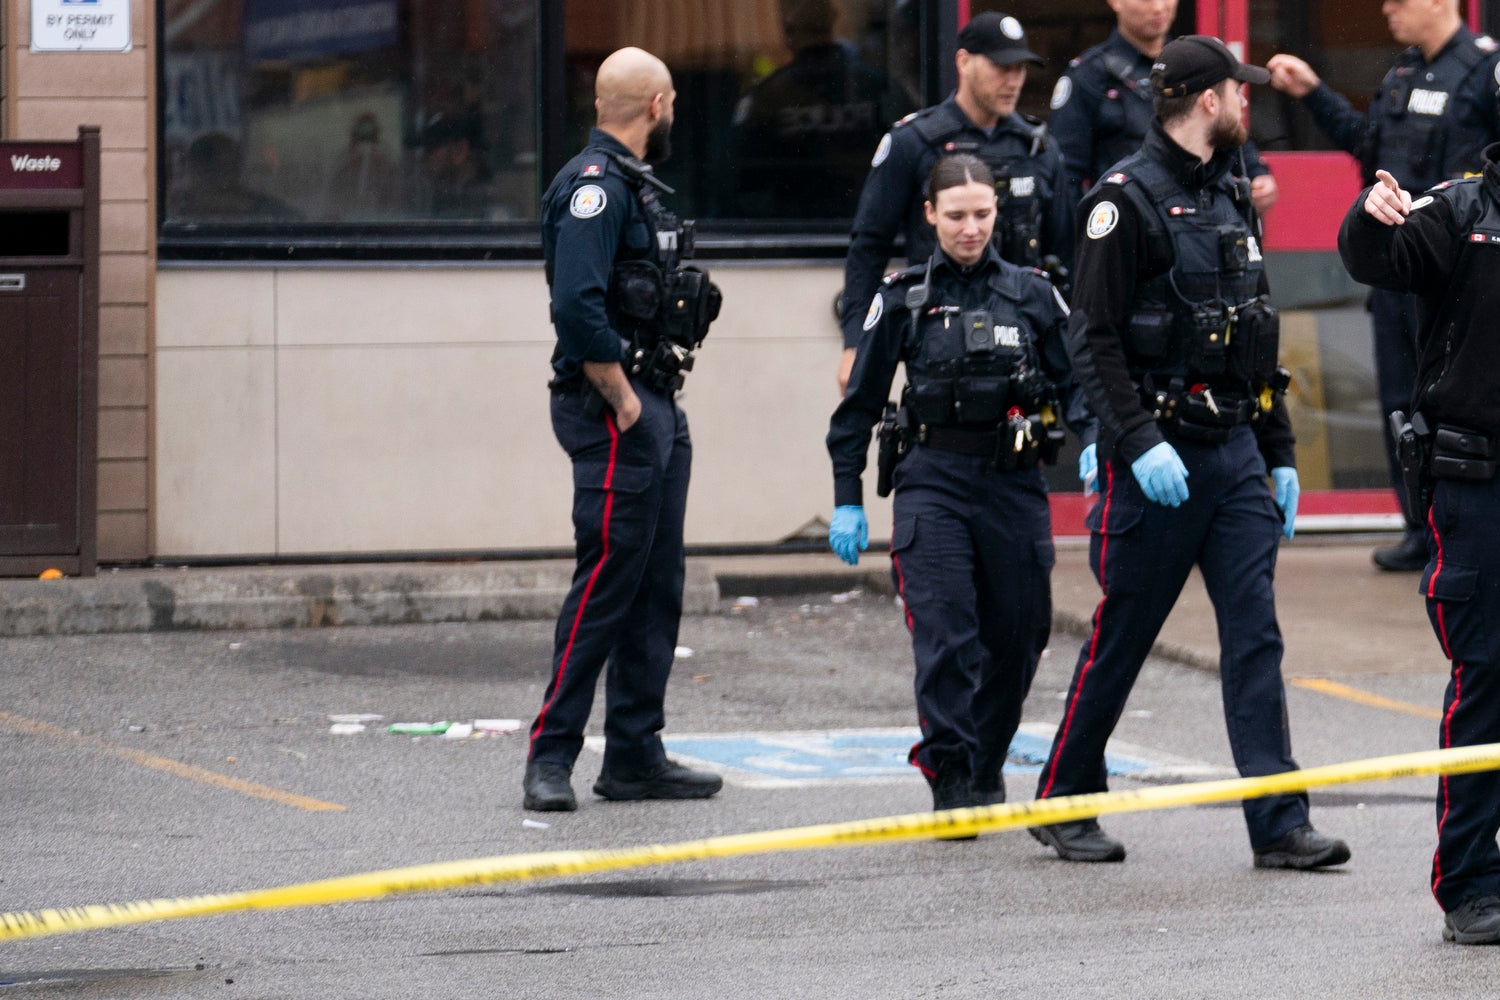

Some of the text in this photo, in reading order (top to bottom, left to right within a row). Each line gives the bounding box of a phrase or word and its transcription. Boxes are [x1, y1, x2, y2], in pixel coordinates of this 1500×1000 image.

[46, 14, 114, 26] BY PERMIT
[63, 28, 97, 40] ONLY
[1408, 88, 1449, 115] POLICE
[10, 154, 61, 172] Waste
[994, 325, 1020, 347] POLICE
